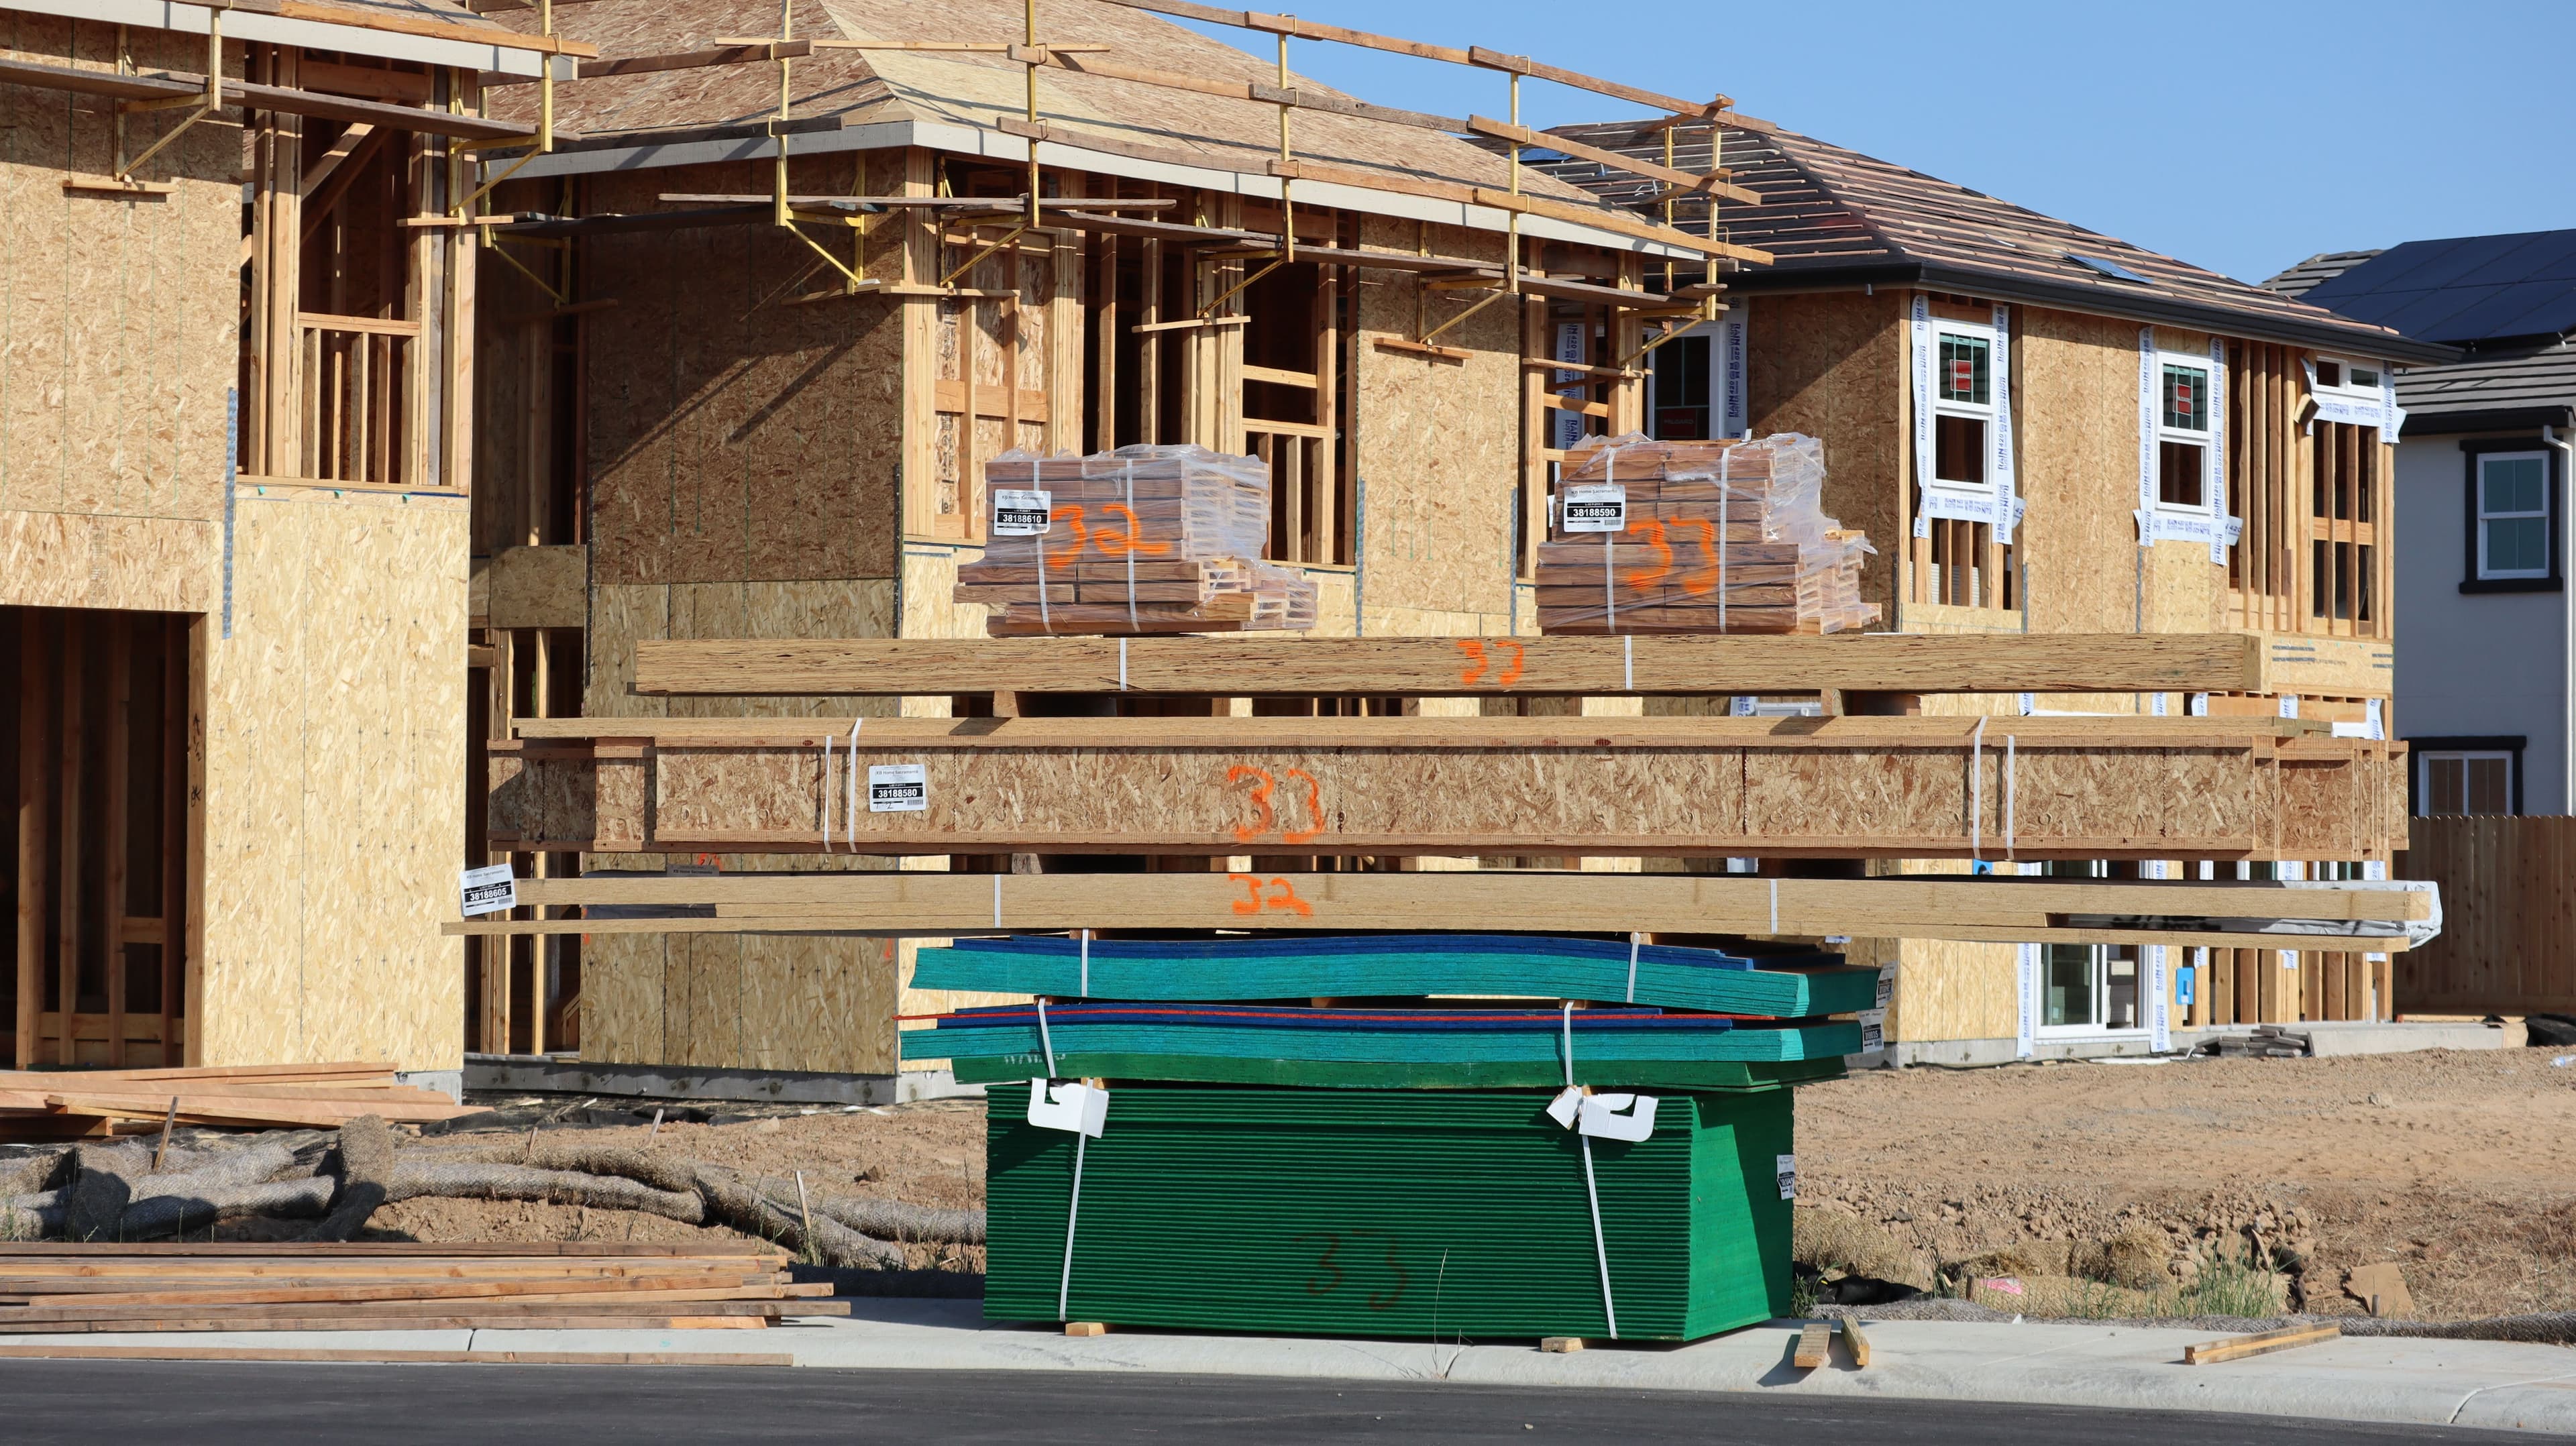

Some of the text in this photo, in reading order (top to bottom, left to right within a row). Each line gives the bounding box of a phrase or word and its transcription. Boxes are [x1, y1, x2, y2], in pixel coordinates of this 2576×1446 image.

[1003, 514, 1042, 523] 38188610
[1573, 508, 1616, 516] 38188590
[1049, 504, 1172, 570] 32
[1627, 516, 1720, 593] 33
[878, 789, 917, 797] 38188580
[470, 887, 506, 901] 38188605
[1228, 873, 1313, 918] 32
